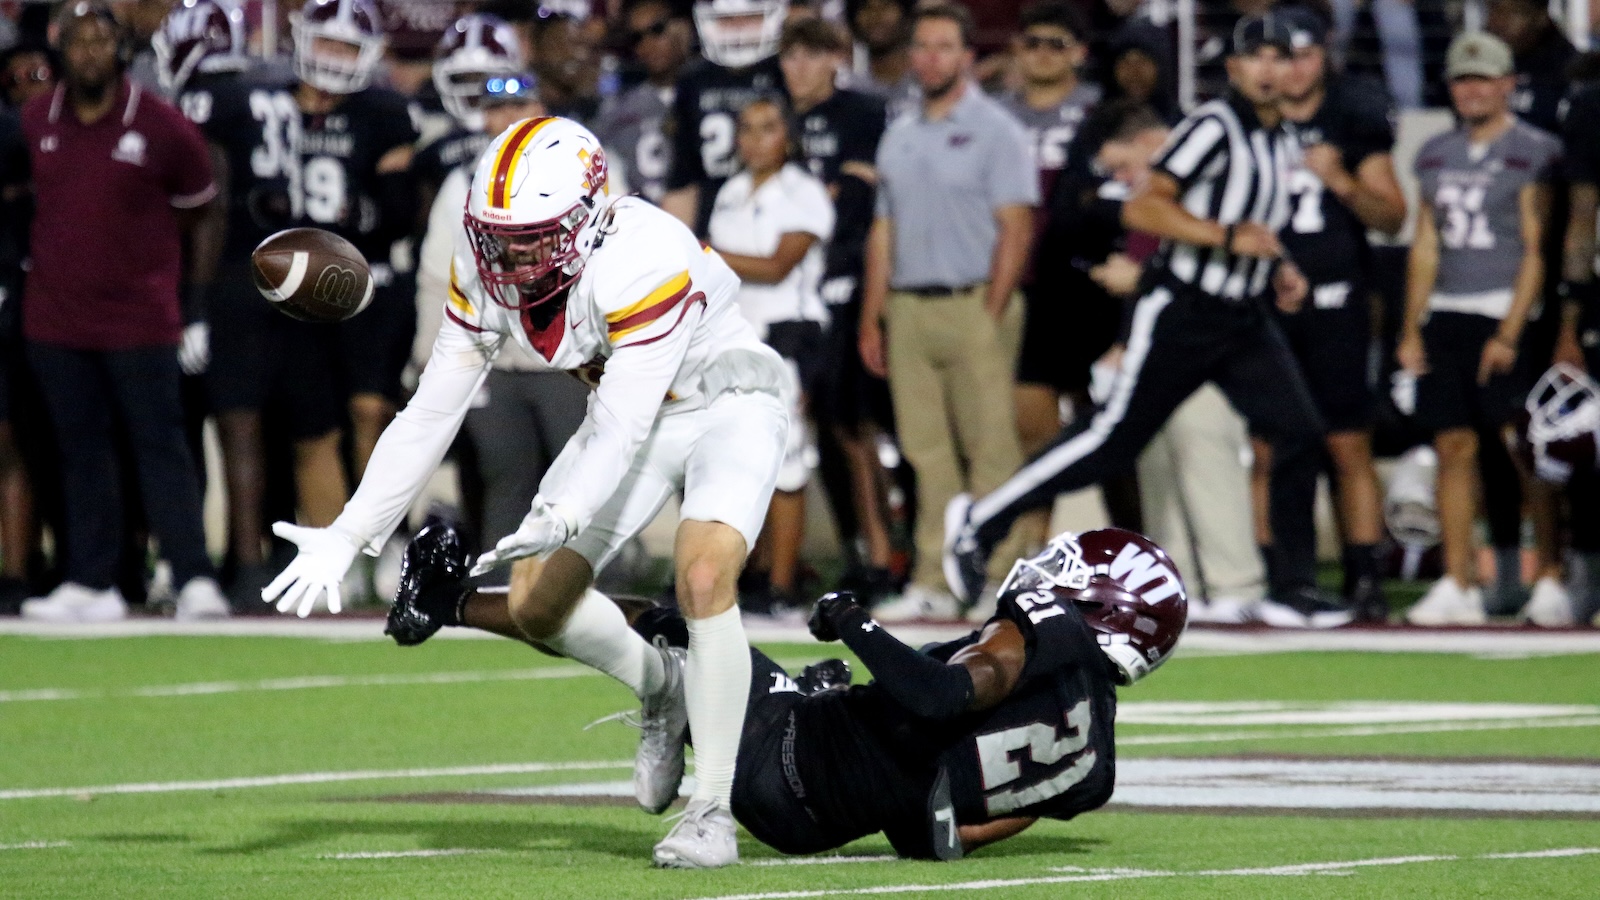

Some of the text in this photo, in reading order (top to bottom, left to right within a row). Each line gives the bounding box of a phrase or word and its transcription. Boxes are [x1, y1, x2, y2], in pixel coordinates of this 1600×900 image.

[1109, 542, 1187, 606] WT
[1015, 588, 1066, 625] 21
[976, 698, 1097, 818] 21
